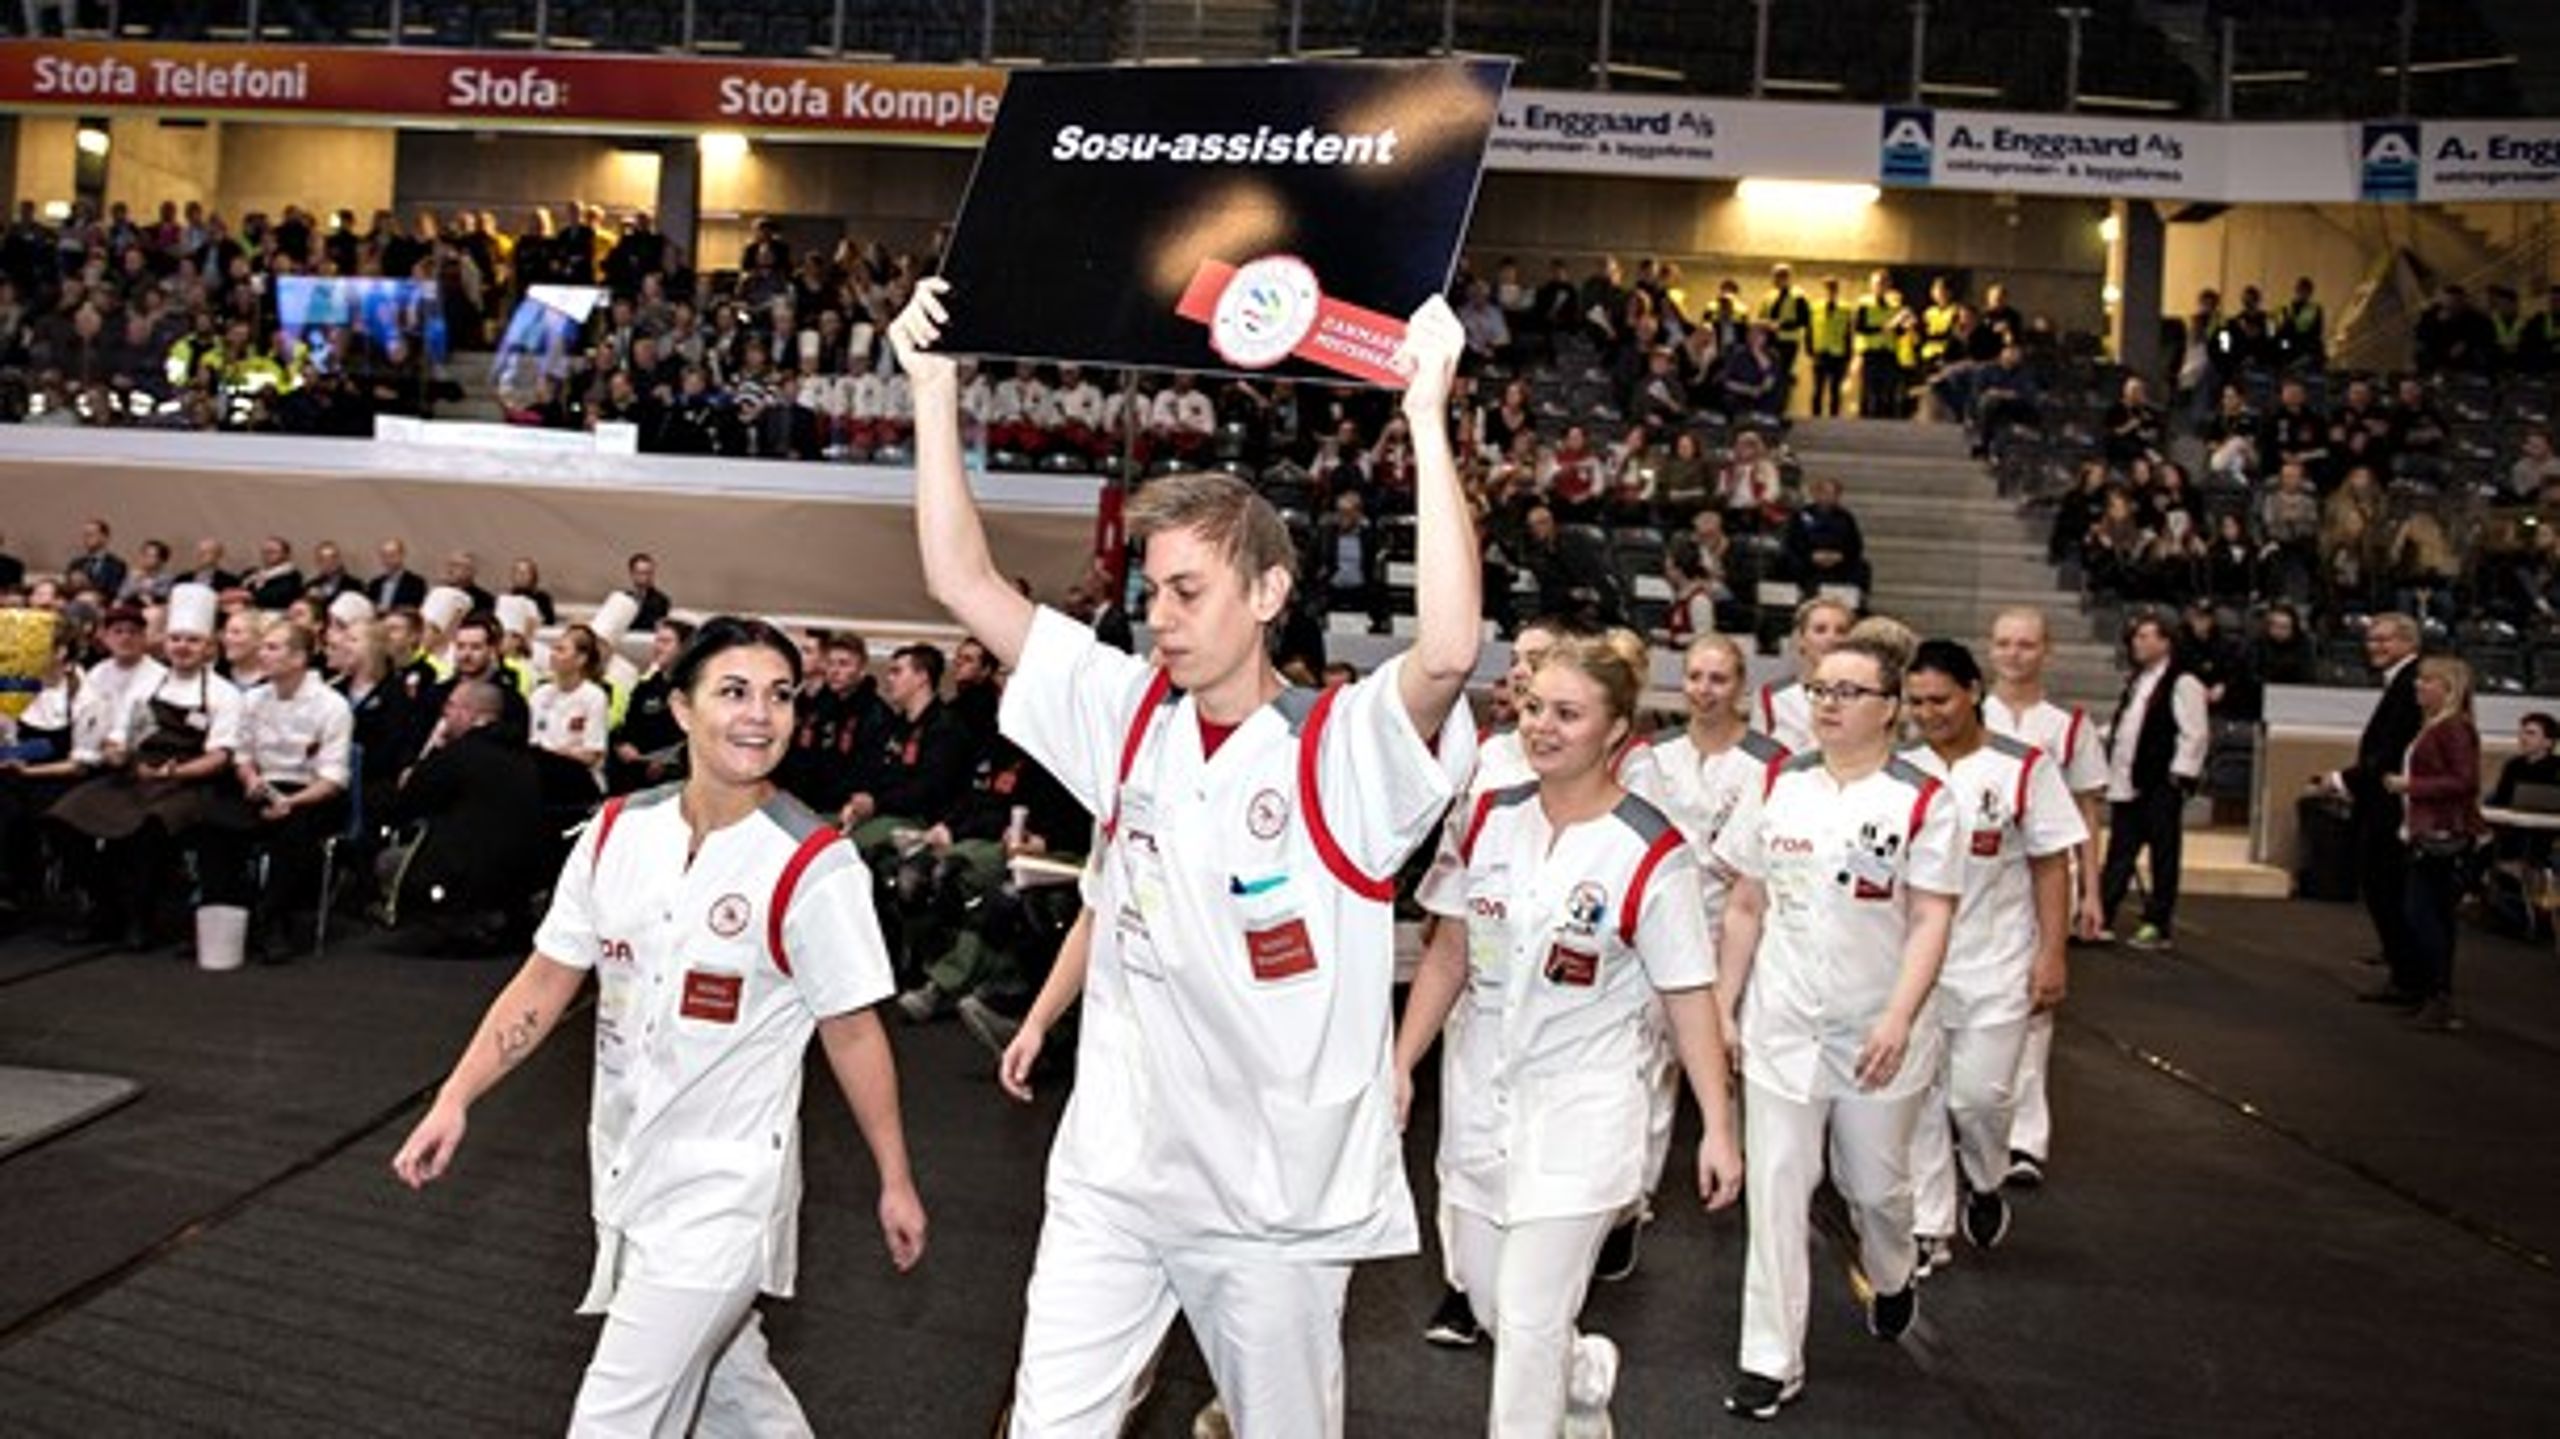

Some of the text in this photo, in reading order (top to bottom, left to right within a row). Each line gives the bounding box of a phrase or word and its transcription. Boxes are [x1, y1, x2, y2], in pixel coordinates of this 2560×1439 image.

[33, 55, 308, 99] Stofa Telefoni
[719, 76, 999, 127] Stofa Komple
[1525, 105, 1672, 138] Enggaard
[1052, 124, 1399, 165] Sosu-assistent
[1948, 125, 1986, 149] A.
[1992, 126, 2139, 159] Enggaard
[2436, 136, 2478, 161] A.
